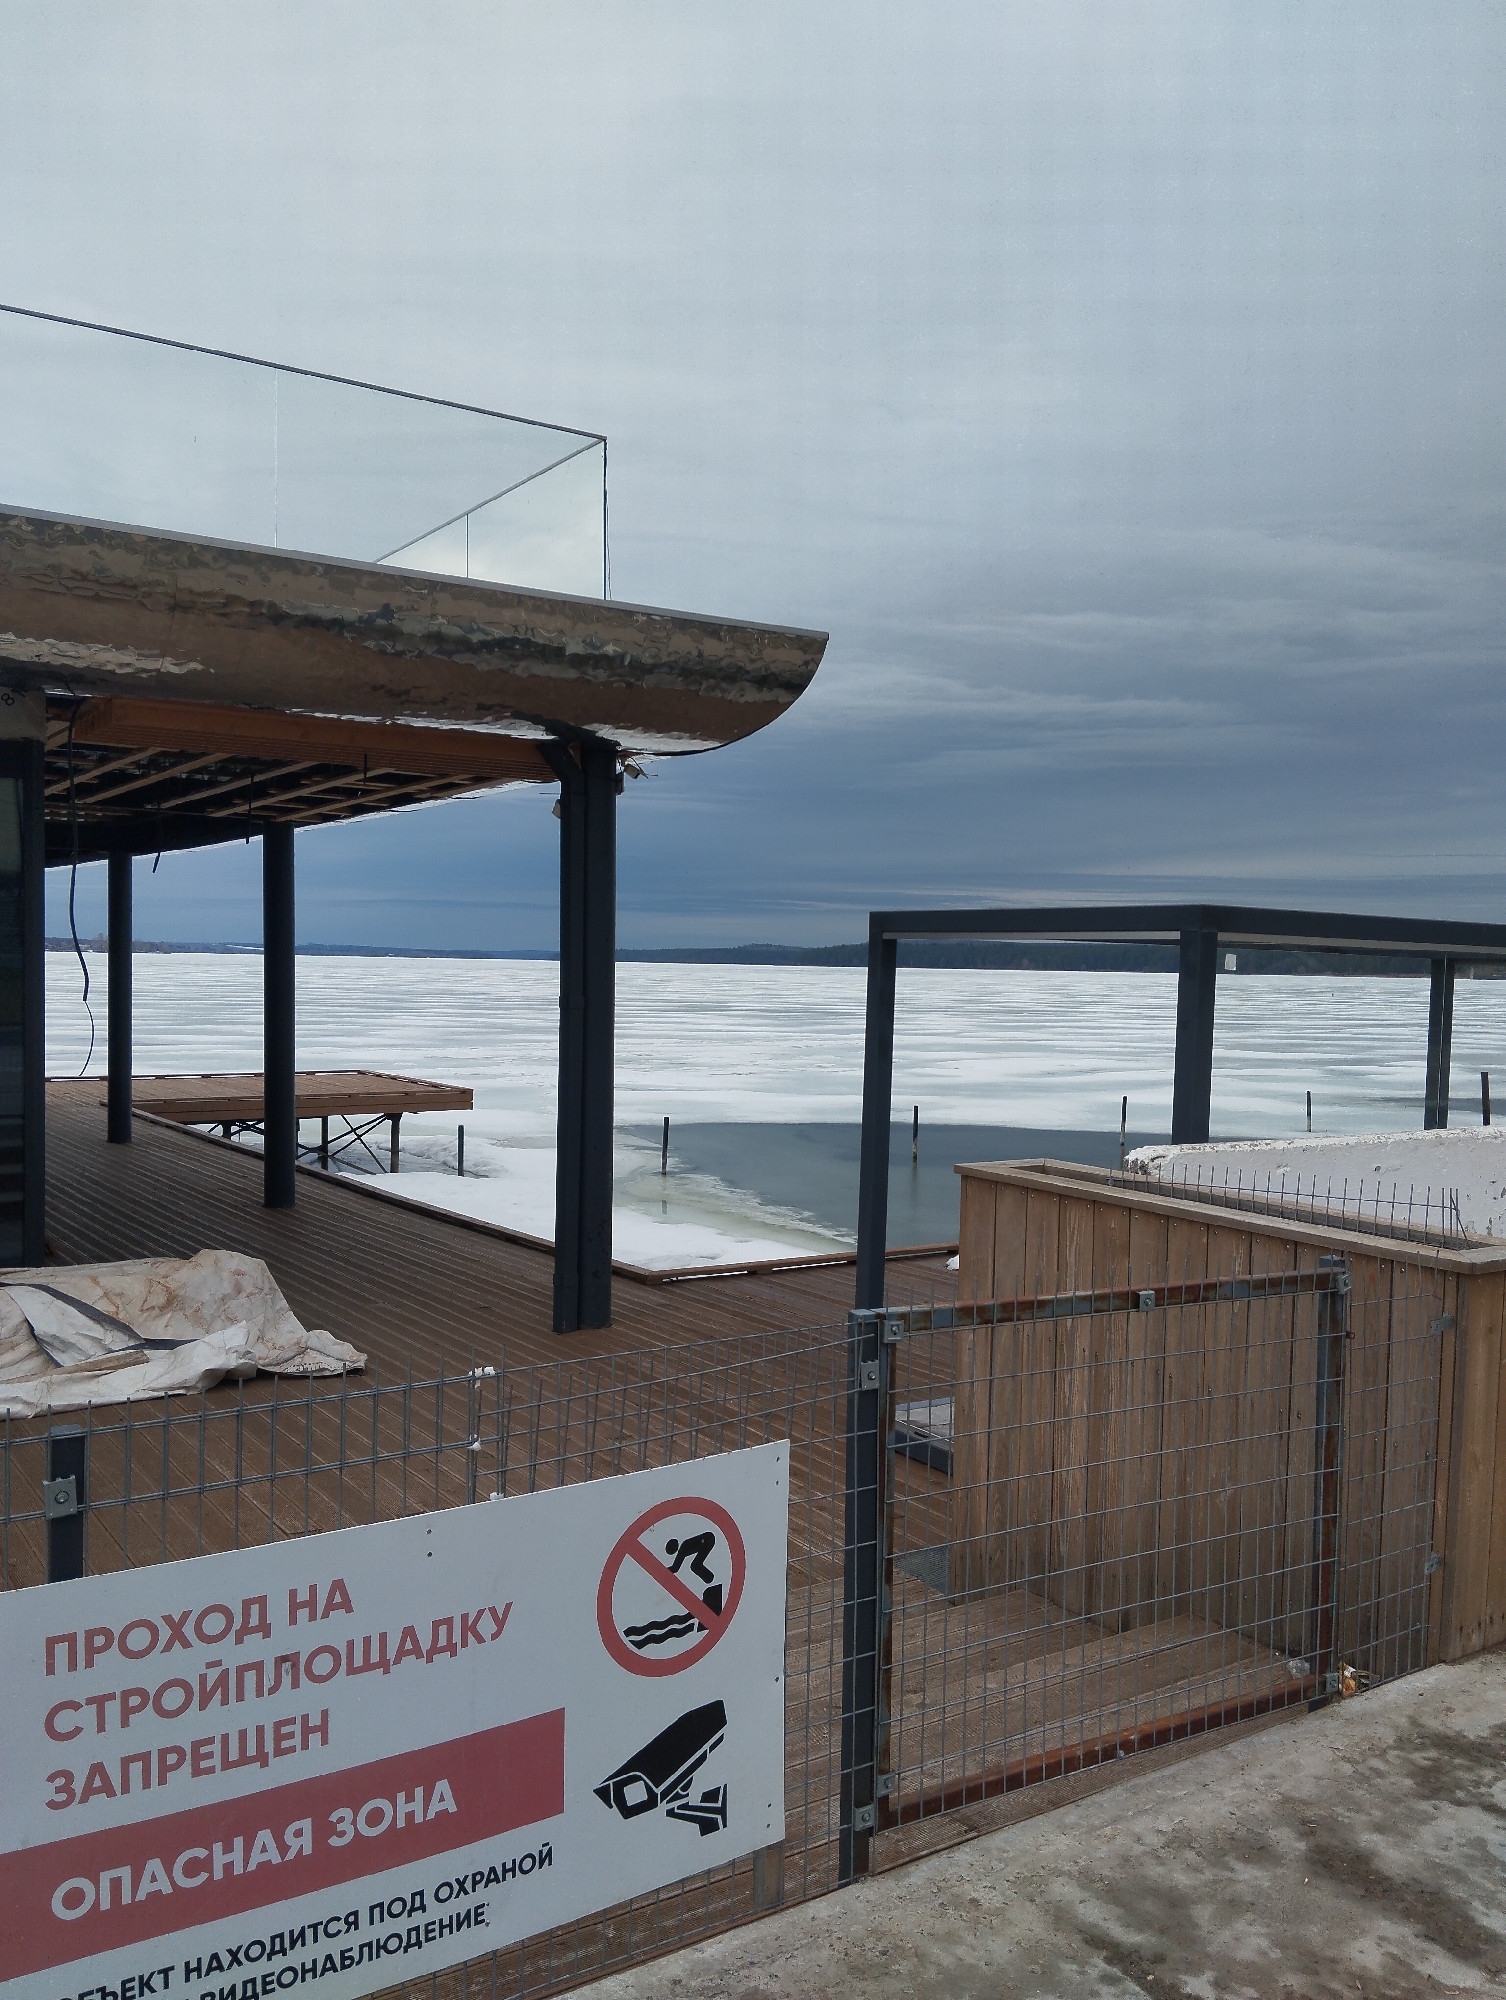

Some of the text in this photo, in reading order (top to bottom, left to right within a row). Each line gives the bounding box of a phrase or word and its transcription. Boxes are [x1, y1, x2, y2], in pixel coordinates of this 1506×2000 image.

[45, 1578, 354, 1676] ПРОХОД НА
[45, 1602, 513, 1742] СТРОЙПЛОЩАДКУ
[45, 1709, 330, 1810] ЗАПРЕЩЕН
[51, 1779, 458, 1921] ОПАСНАЯ ЗОНА
[60, 1841, 553, 2000] ЪЕКТ НАХОДИТСЯ ПОД ОХРАНОЙ
